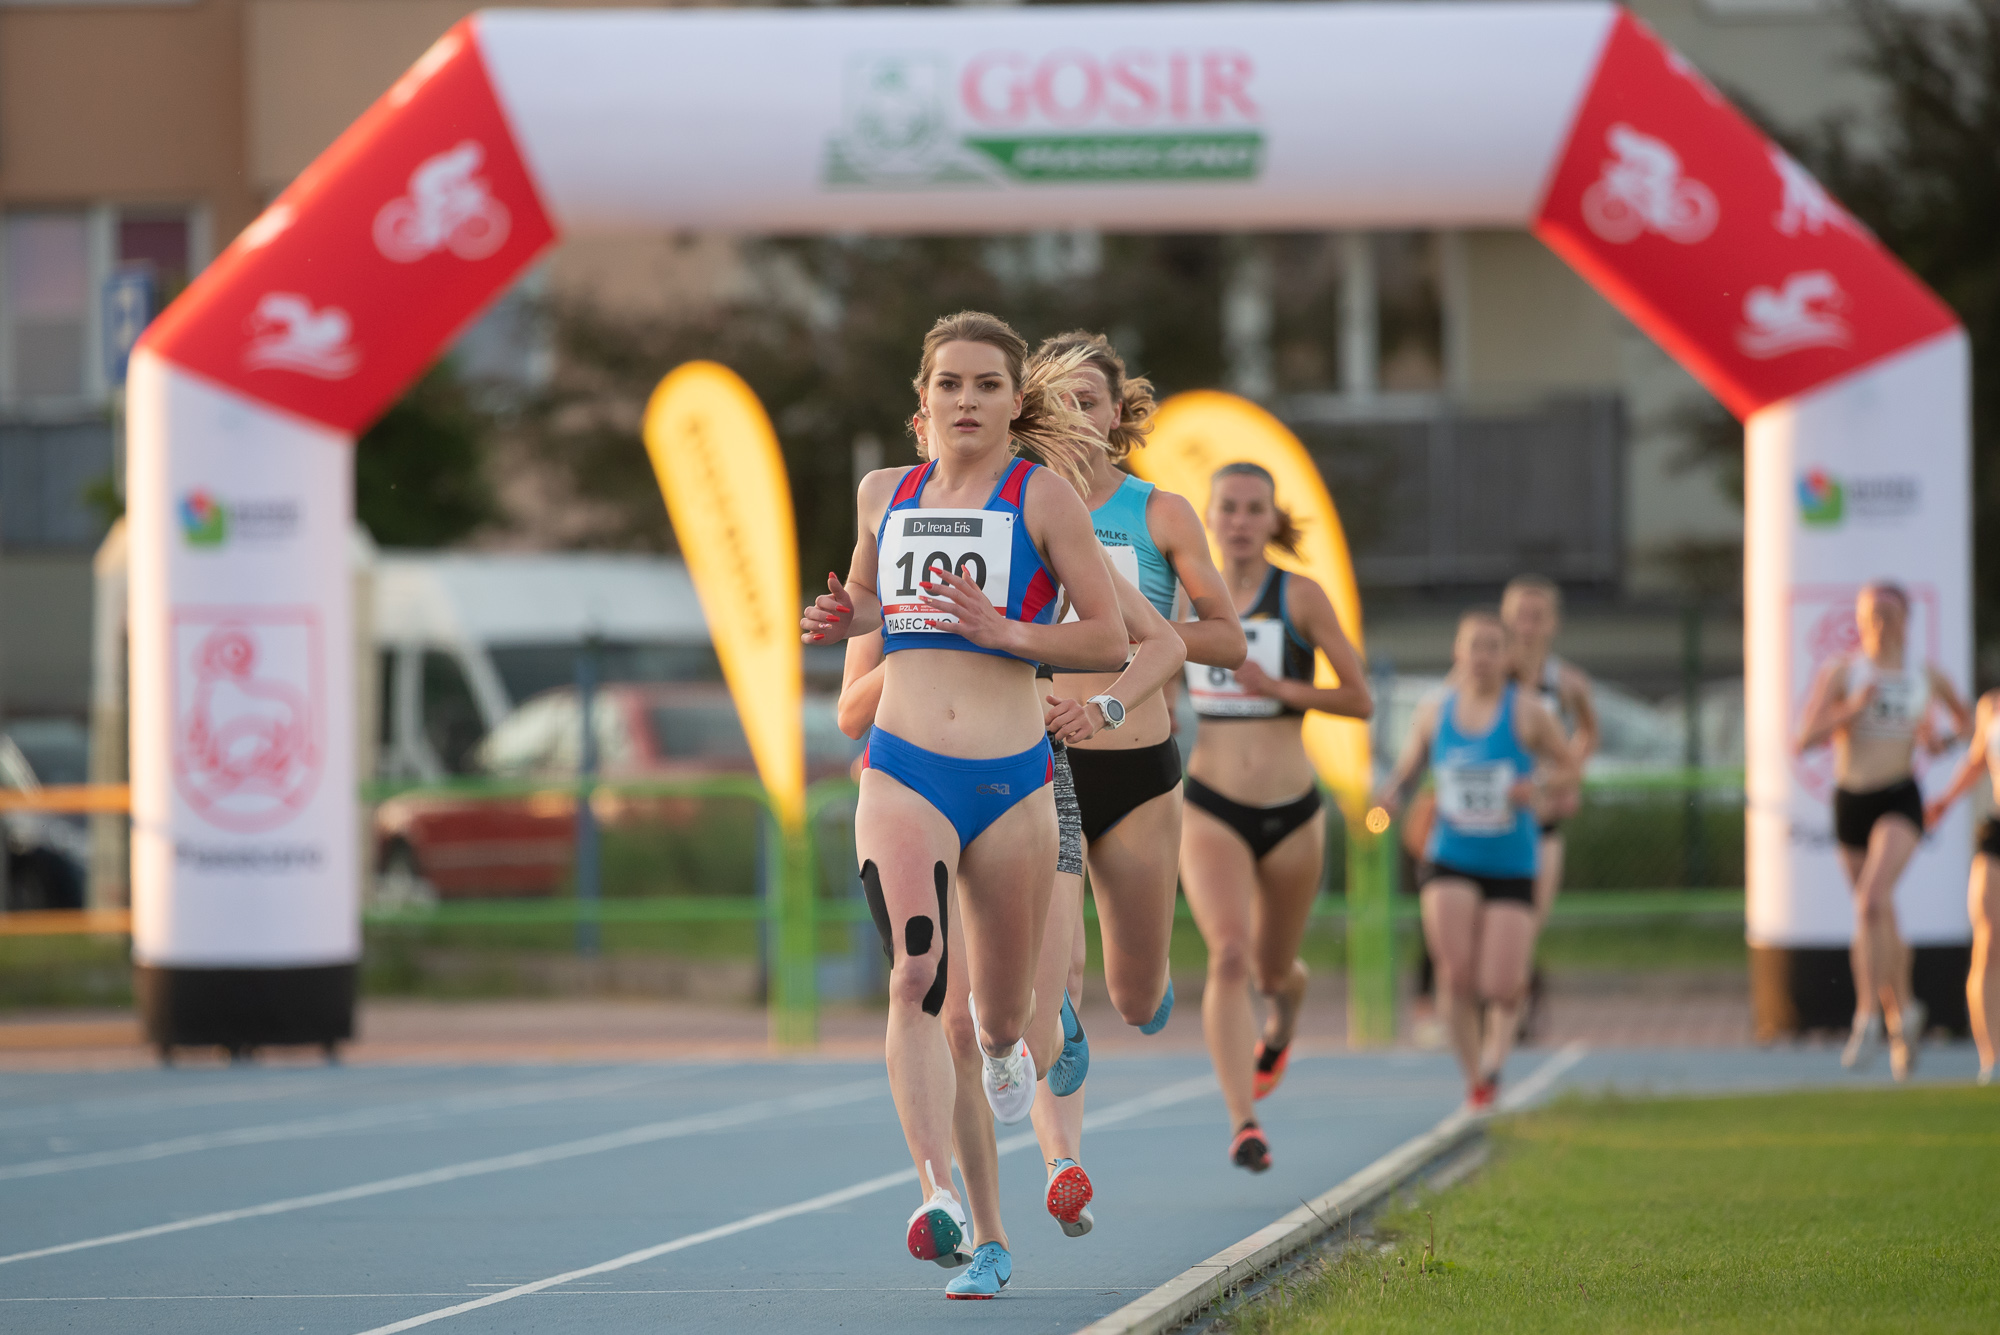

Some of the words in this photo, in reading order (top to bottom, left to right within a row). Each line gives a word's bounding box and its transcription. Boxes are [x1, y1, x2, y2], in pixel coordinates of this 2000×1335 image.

[961, 49, 1262, 127] GOSIR
[913, 521, 926, 533] Dr
[927, 521, 952, 533] Irena
[954, 521, 971, 534] Eris
[895, 551, 987, 597] 100
